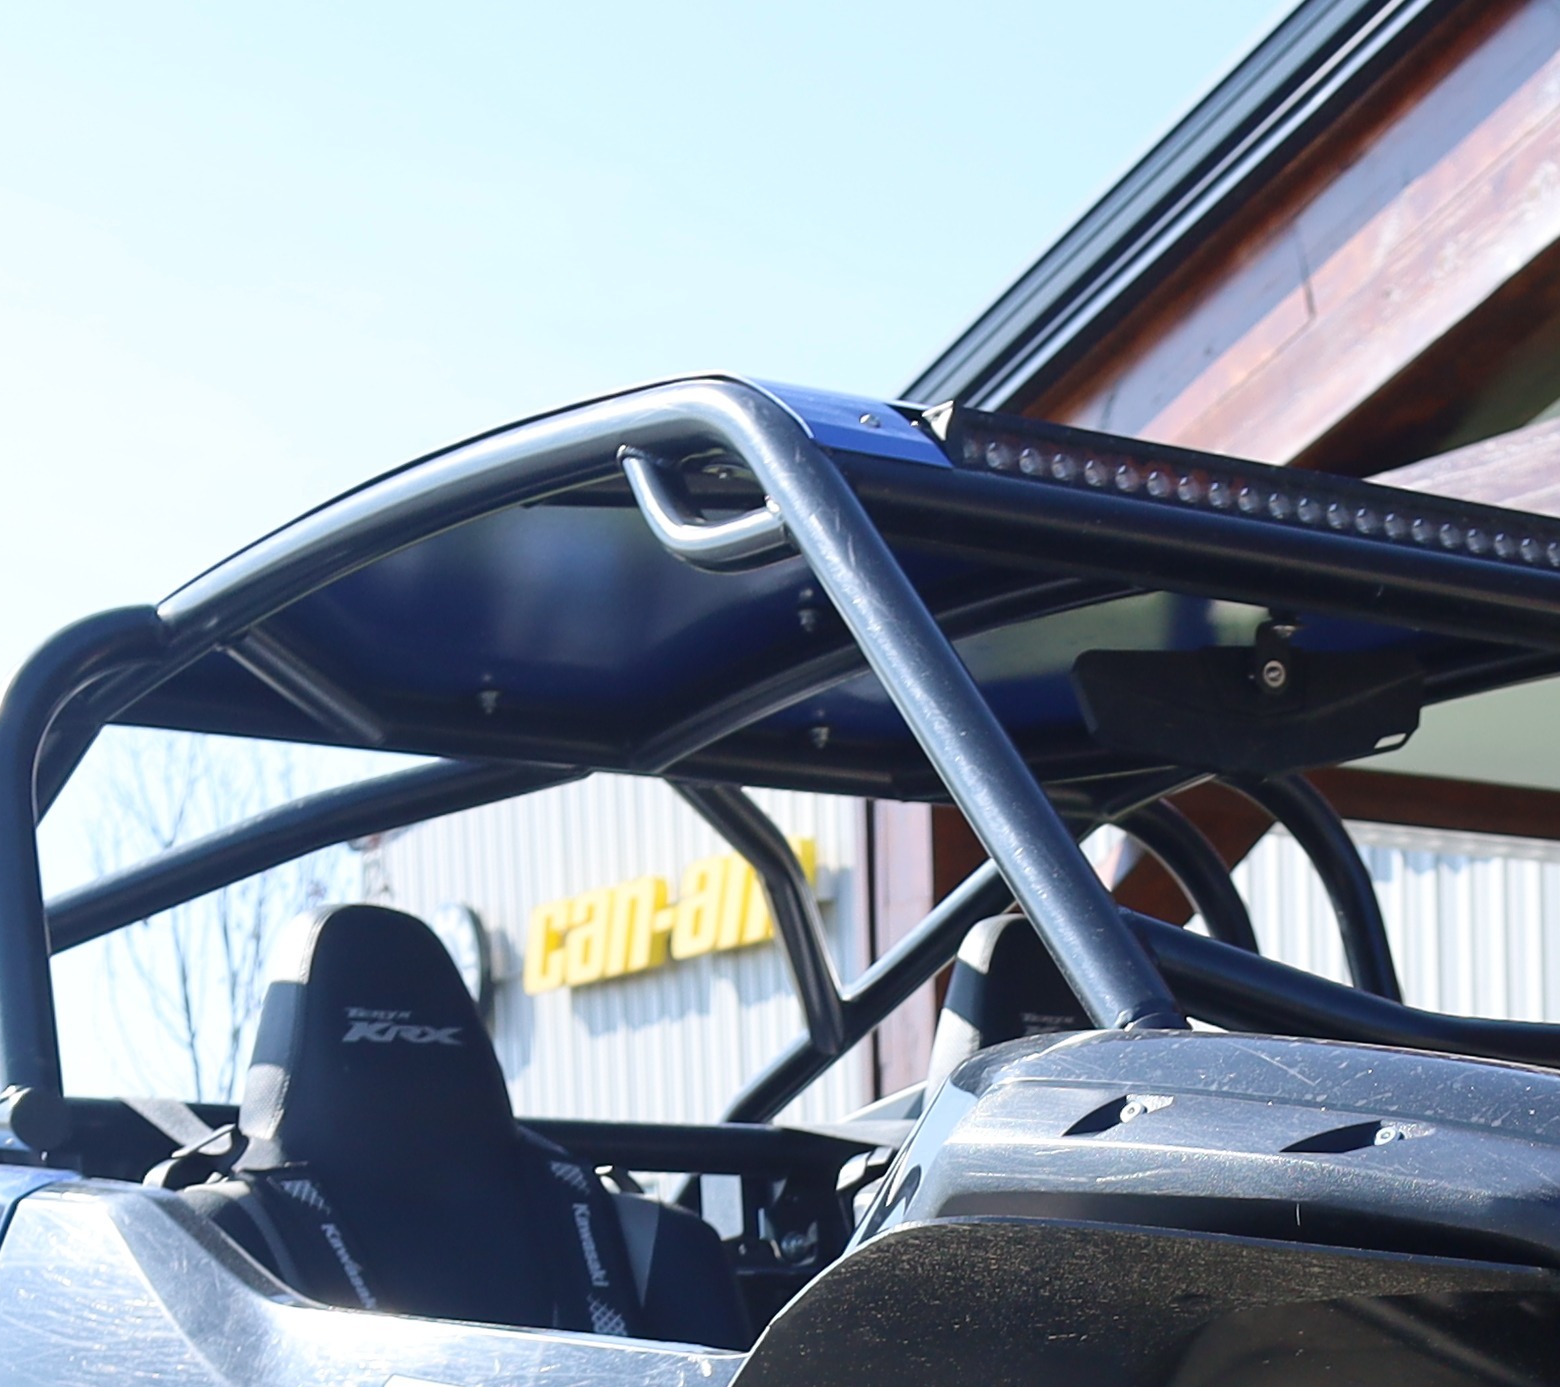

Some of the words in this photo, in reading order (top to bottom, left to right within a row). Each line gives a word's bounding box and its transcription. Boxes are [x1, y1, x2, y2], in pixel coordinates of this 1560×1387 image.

[342, 1021, 463, 1045] KRX
[321, 1223, 377, 1309] Kawasak
[572, 1203, 609, 1287] Kawasaki
